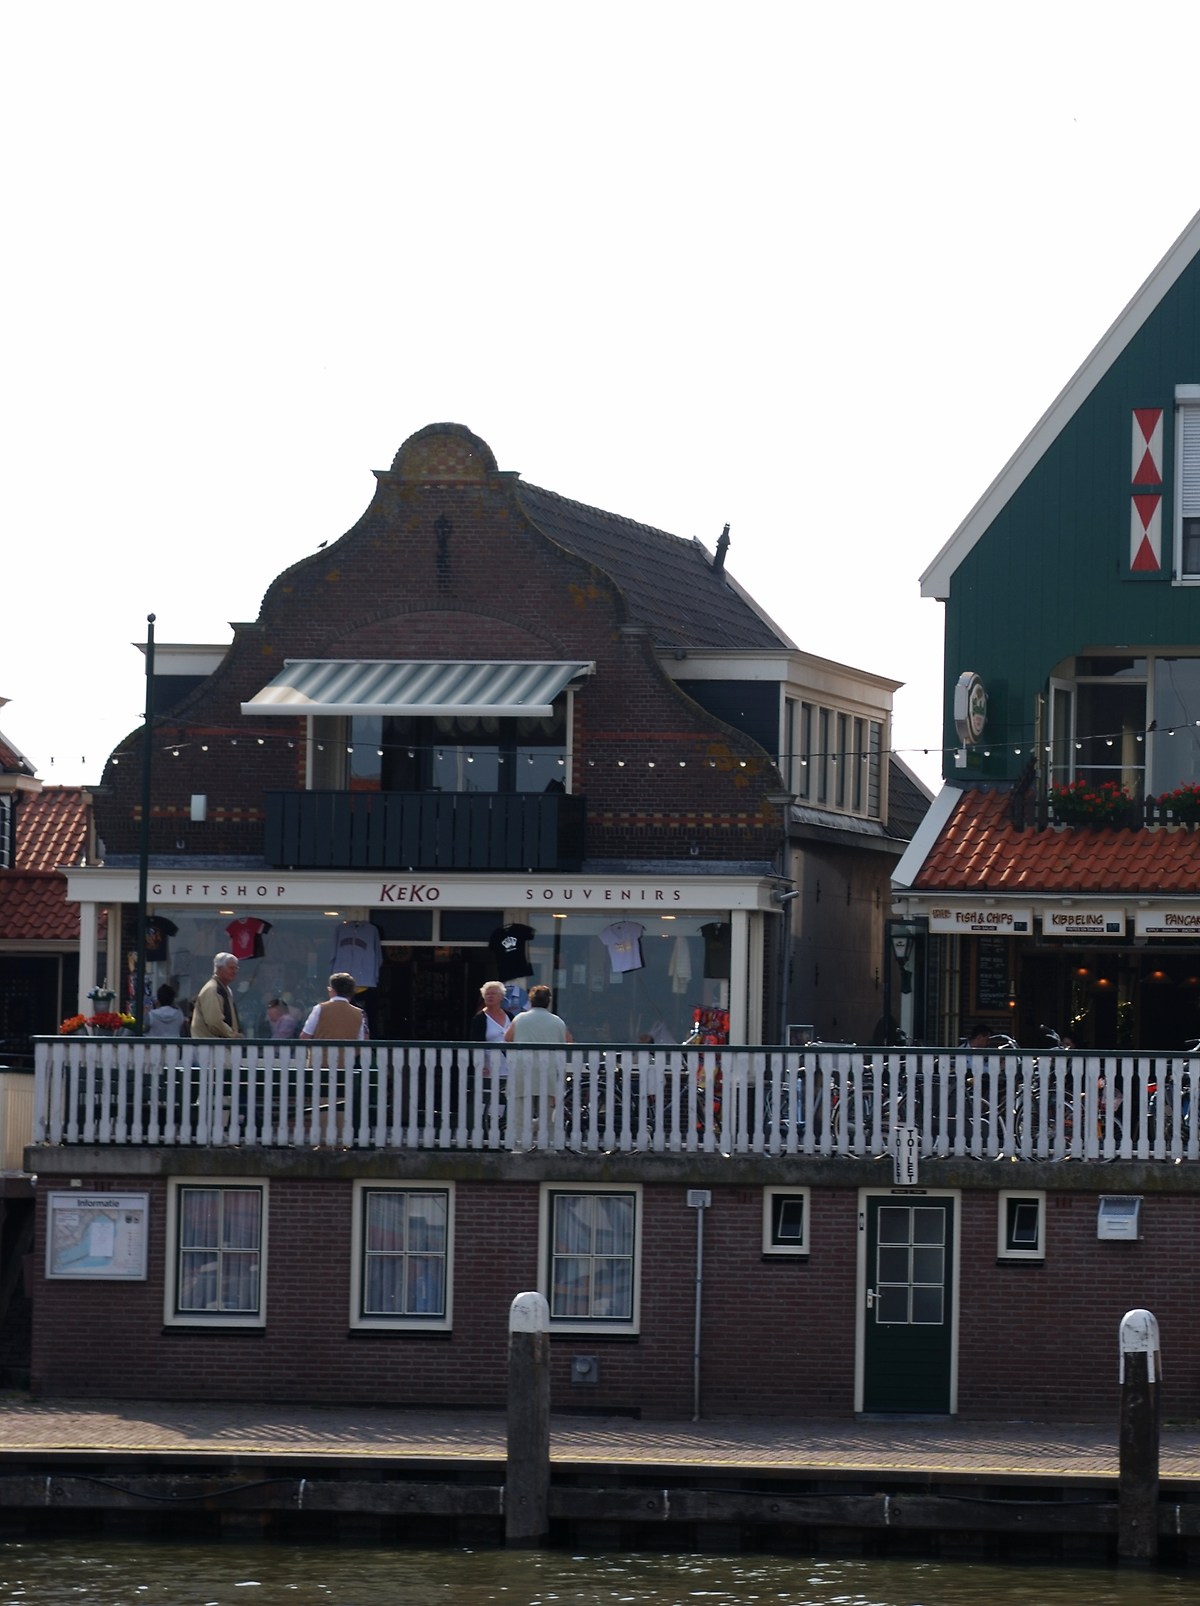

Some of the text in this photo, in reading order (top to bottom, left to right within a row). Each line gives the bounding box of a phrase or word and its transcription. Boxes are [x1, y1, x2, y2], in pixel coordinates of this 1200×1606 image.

[152, 884, 287, 897] GIFTSHOP
[525, 888, 682, 901] SOUVENIRS
[1052, 914, 1104, 925] KIBBELING
[77, 1199, 120, 1208] Informatie
